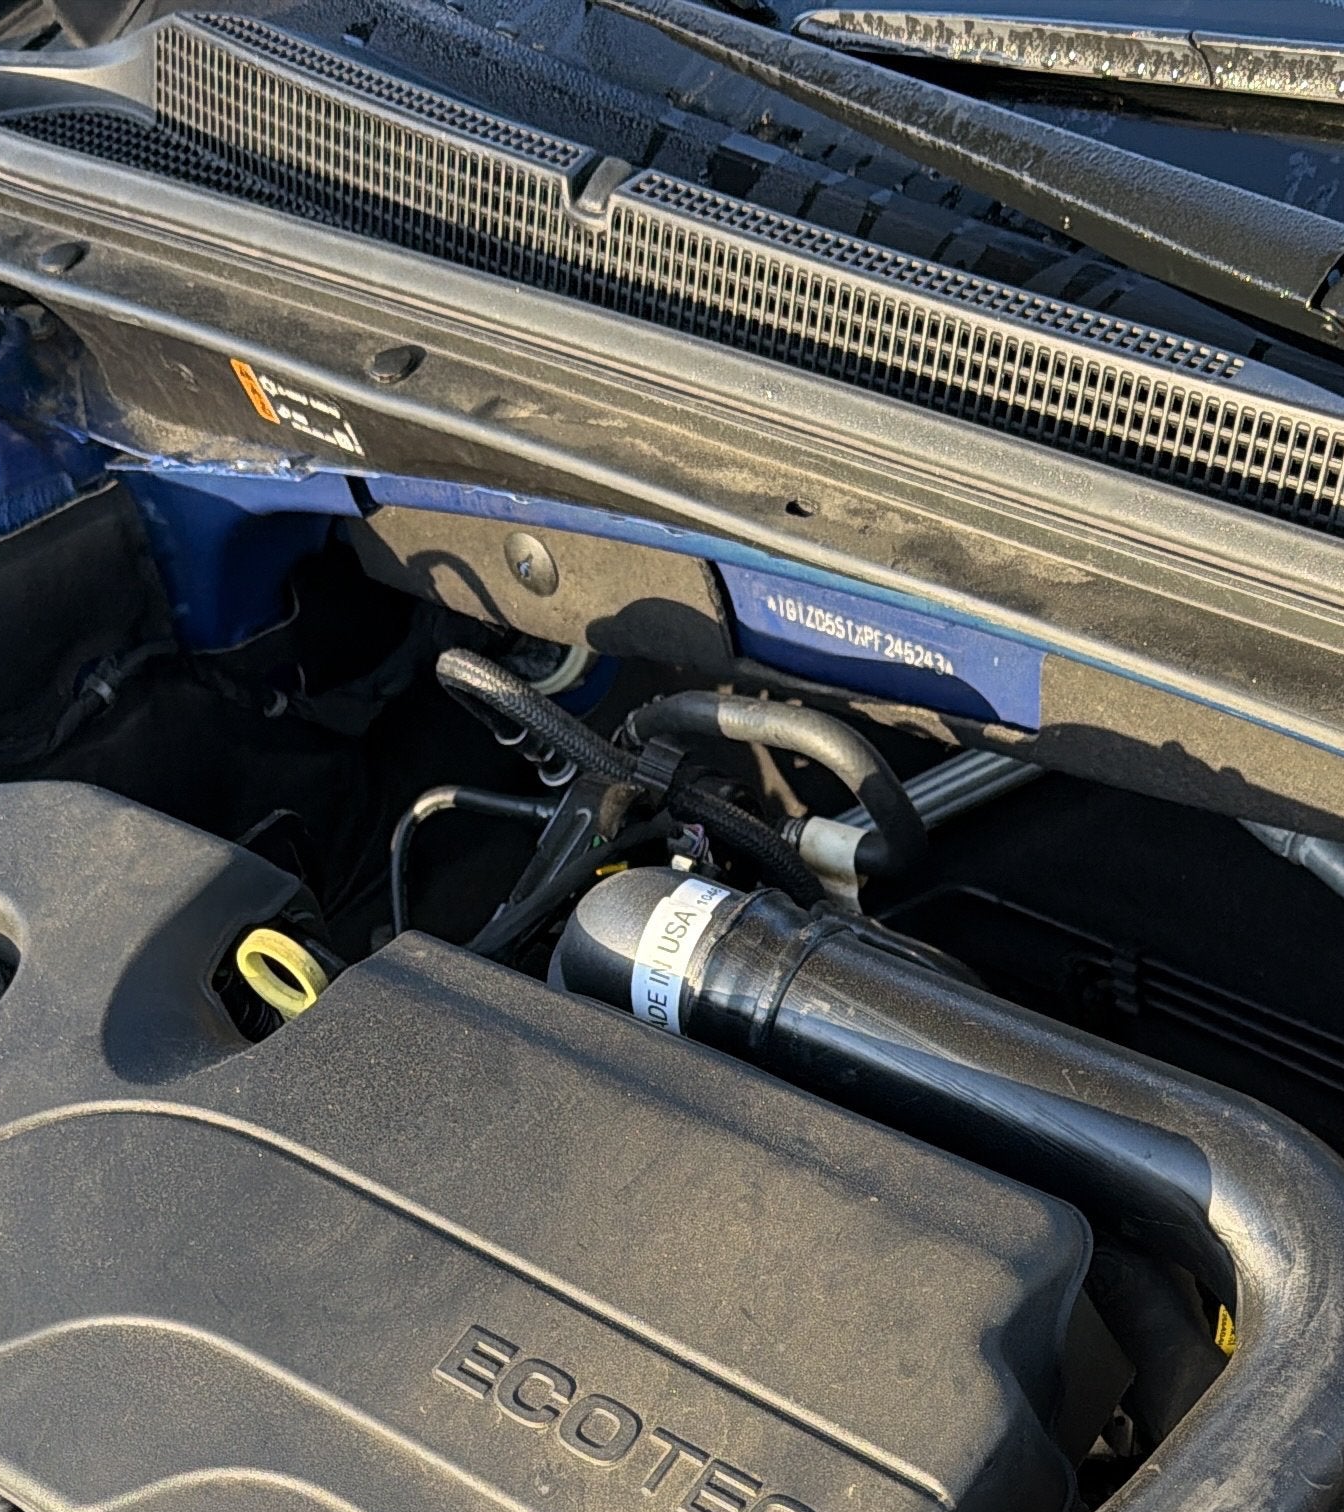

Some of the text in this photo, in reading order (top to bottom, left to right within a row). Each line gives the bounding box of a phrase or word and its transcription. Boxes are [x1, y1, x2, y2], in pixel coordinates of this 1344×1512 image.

[648, 911, 697, 1029] ADE IN USA
